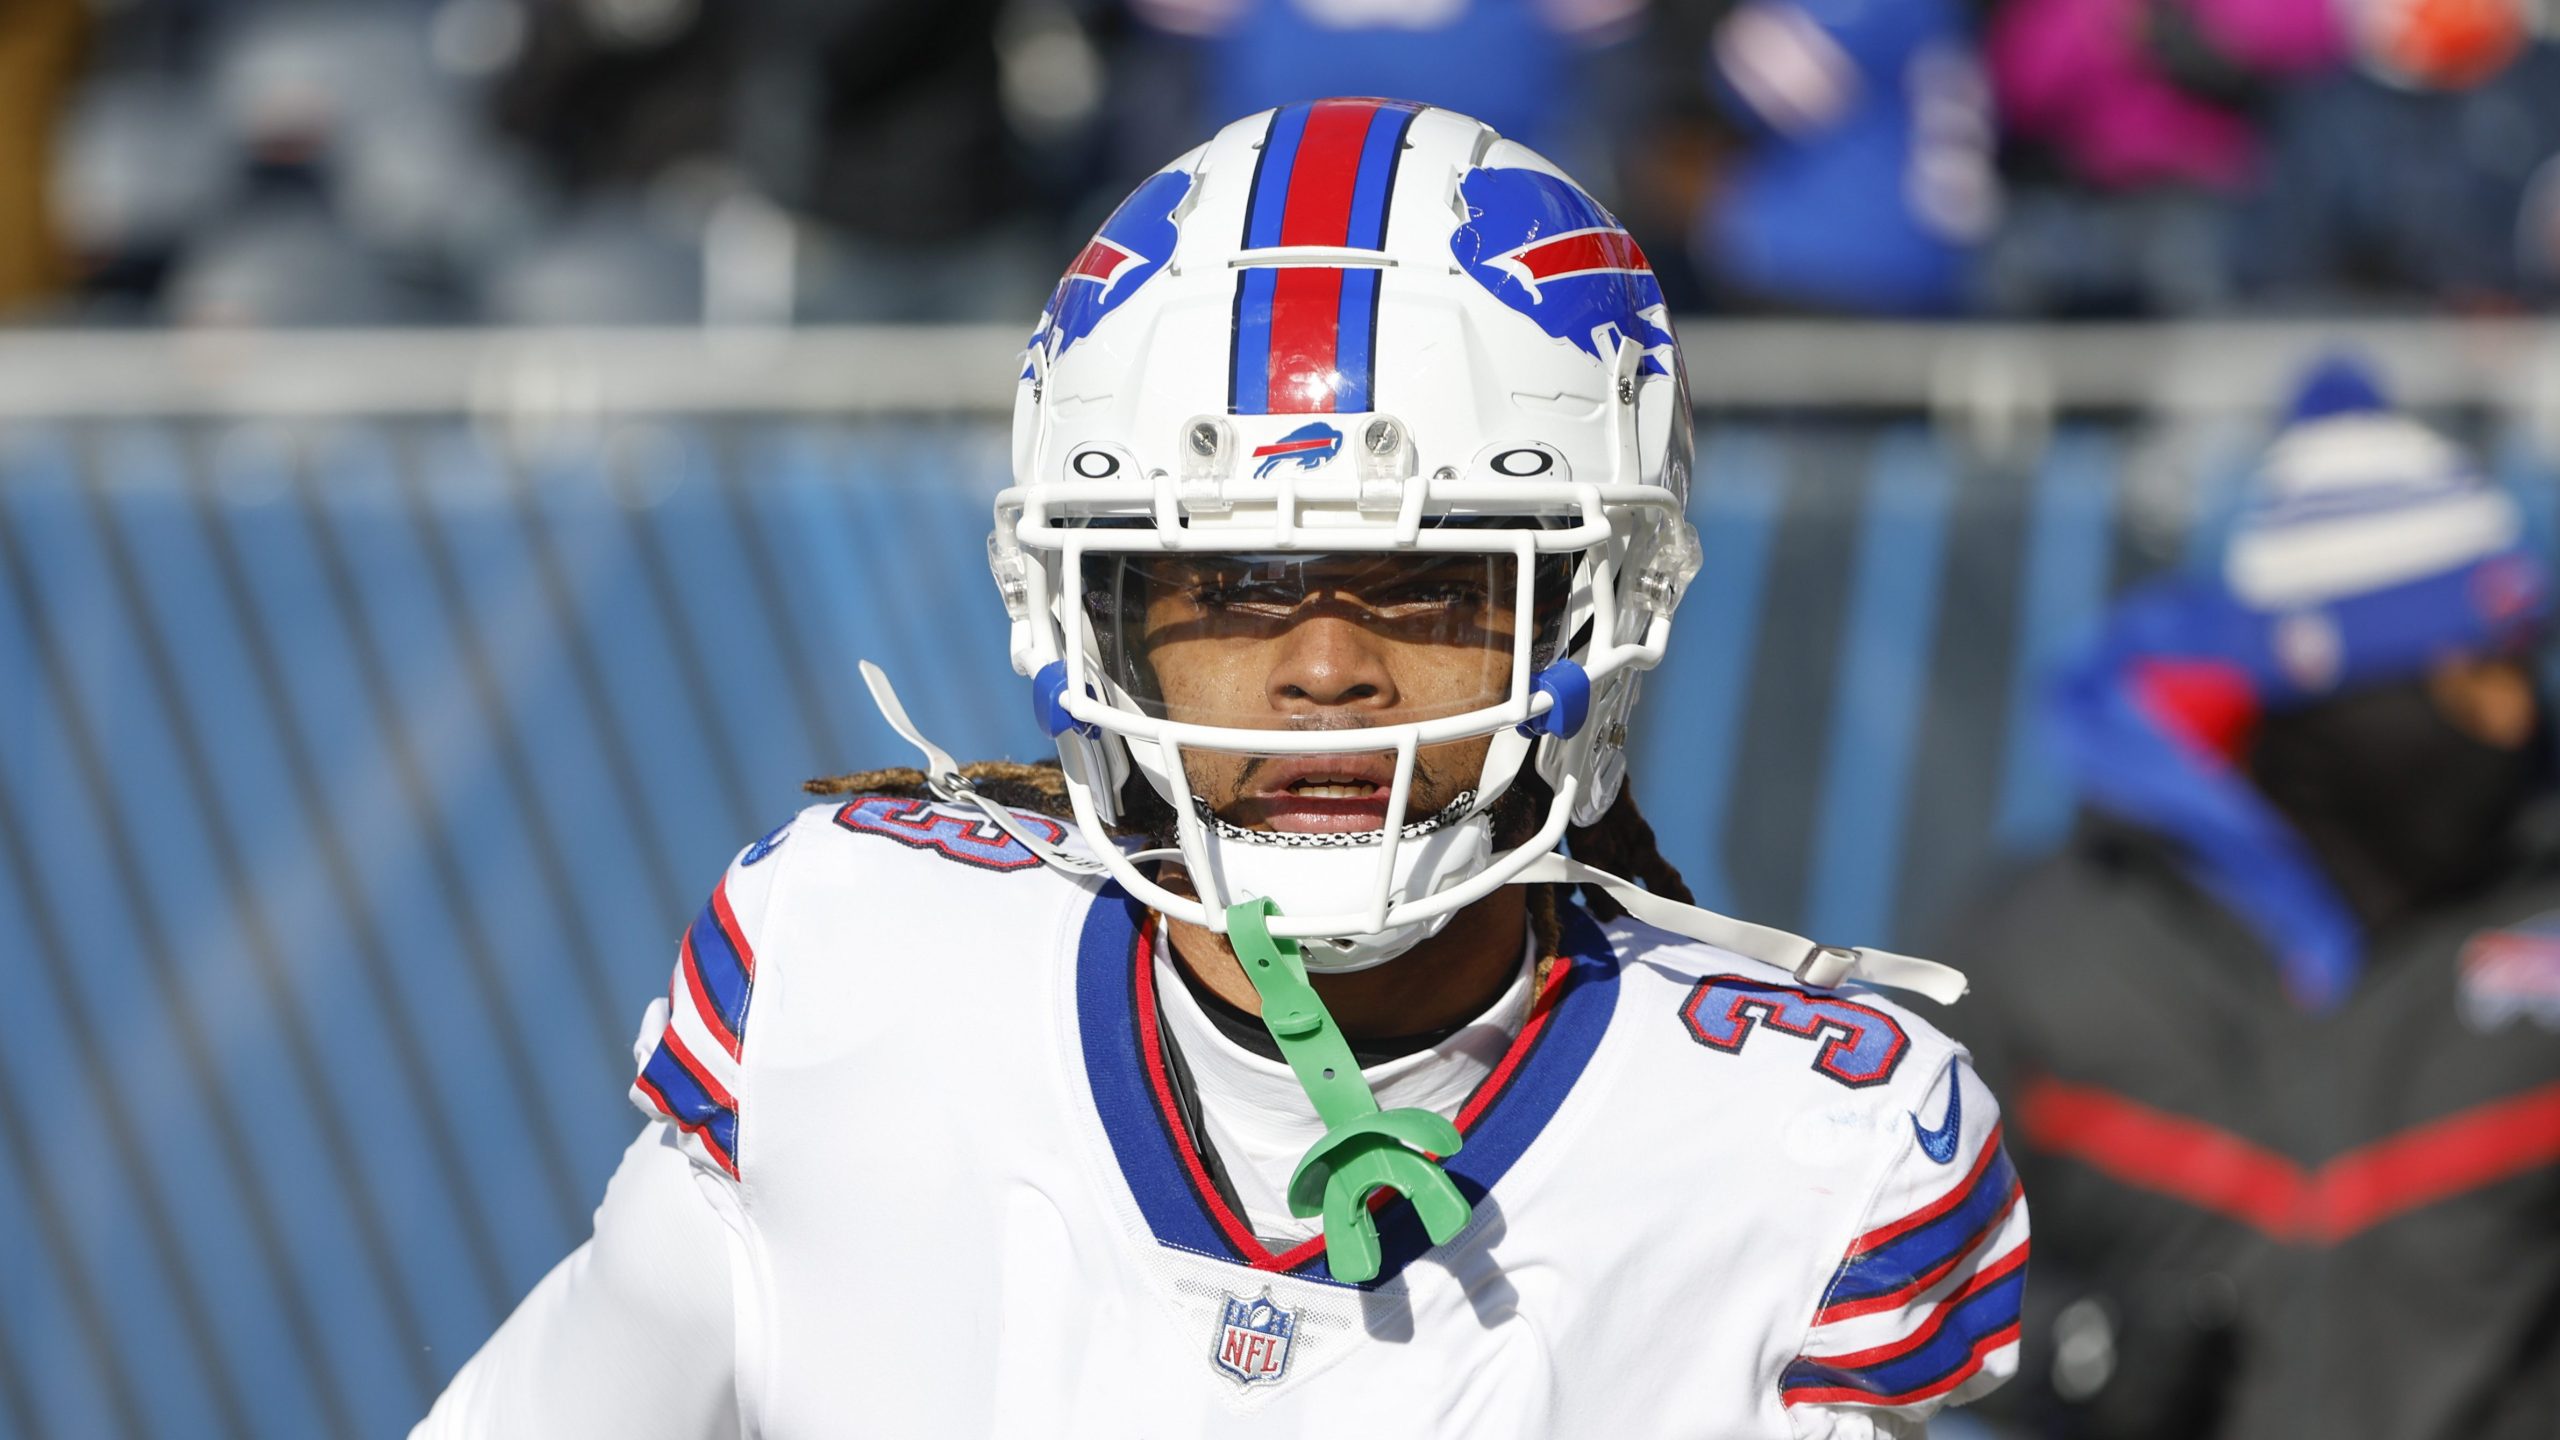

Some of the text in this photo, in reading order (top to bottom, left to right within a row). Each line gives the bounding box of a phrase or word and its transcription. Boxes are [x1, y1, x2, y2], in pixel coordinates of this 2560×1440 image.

[833, 796, 1069, 872] 3
[1678, 974, 1911, 1089] 3
[1222, 1327, 1279, 1374] NFL
